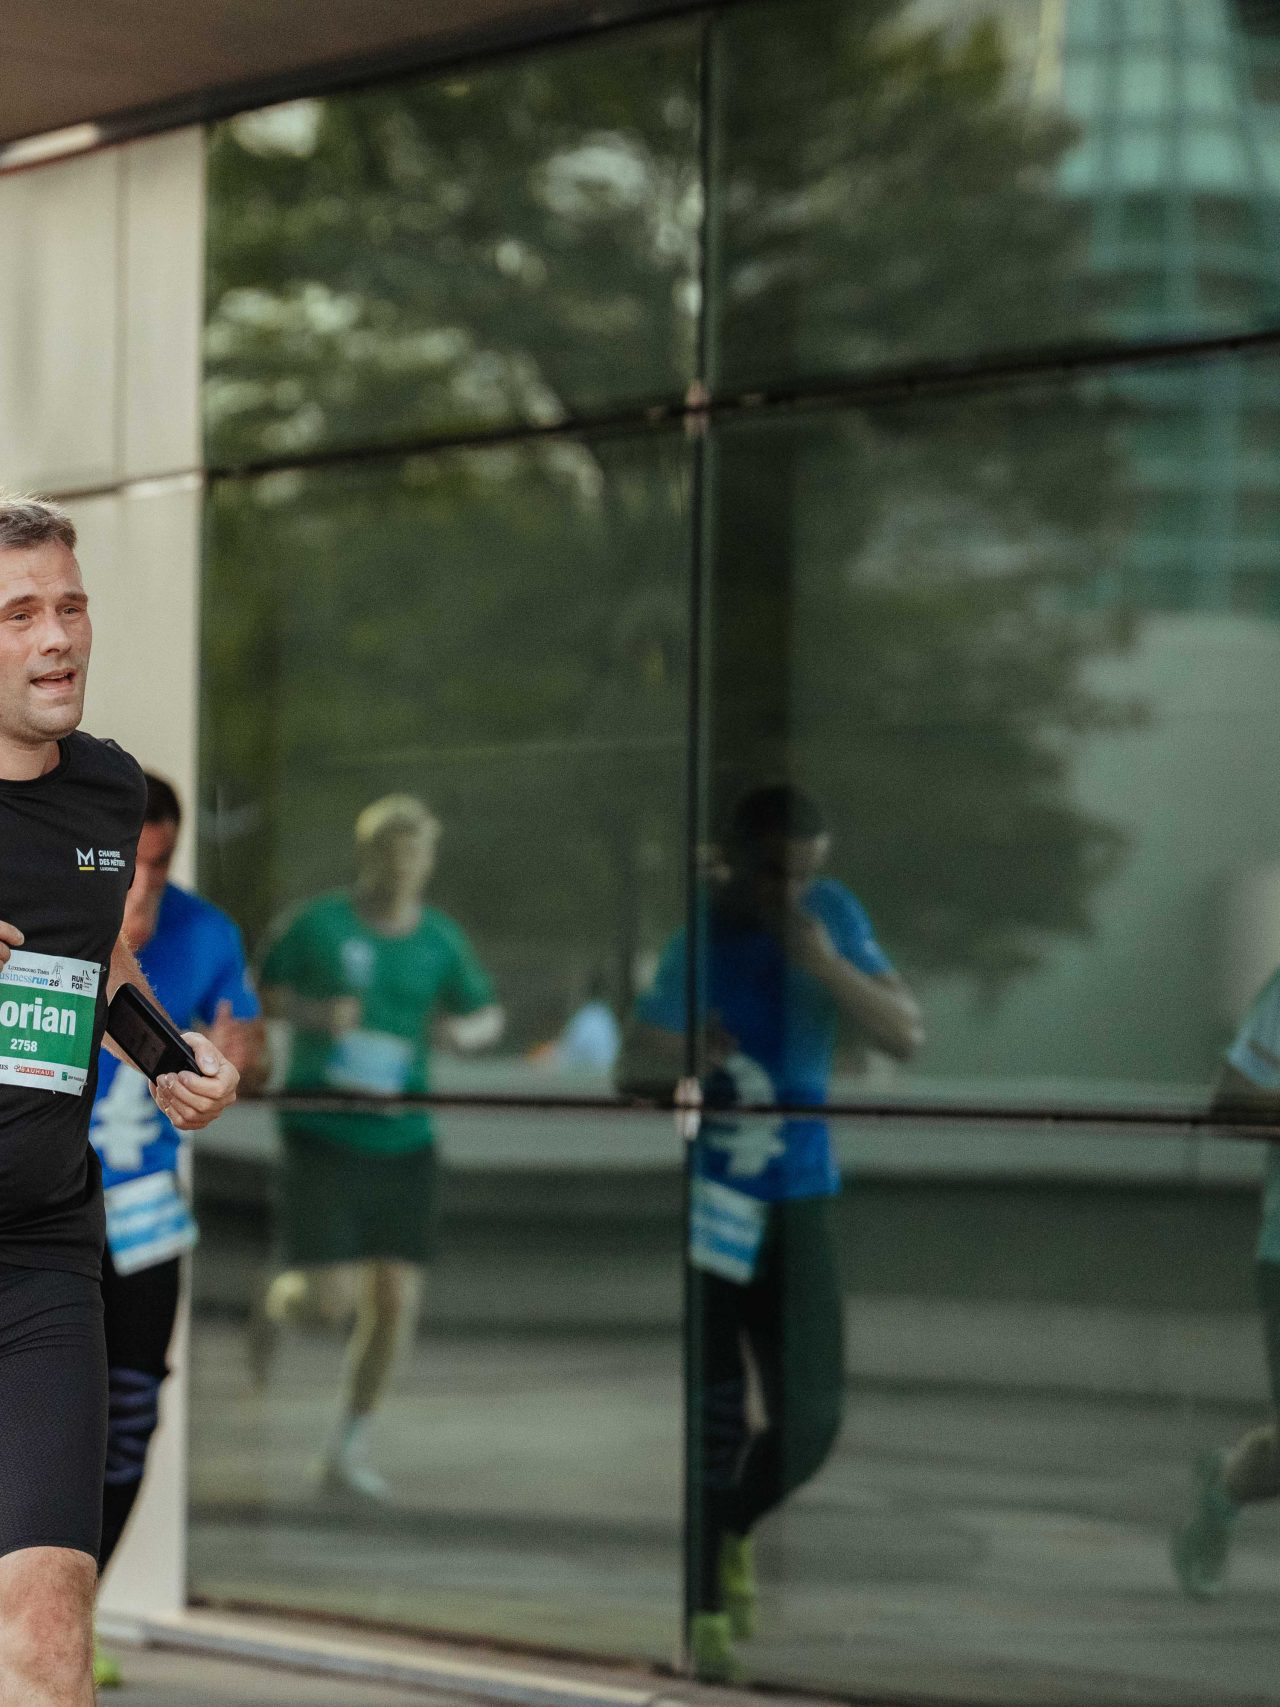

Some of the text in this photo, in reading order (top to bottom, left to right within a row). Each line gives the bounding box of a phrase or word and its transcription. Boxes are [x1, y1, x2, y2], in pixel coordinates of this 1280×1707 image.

[76, 848, 95, 866] M
[99, 858, 110, 866] DES
[0, 971, 60, 987] usinessrun 26
[71, 975, 84, 984] RUN
[71, 982, 83, 991] FOR
[10, 1038, 38, 1052] 2758
